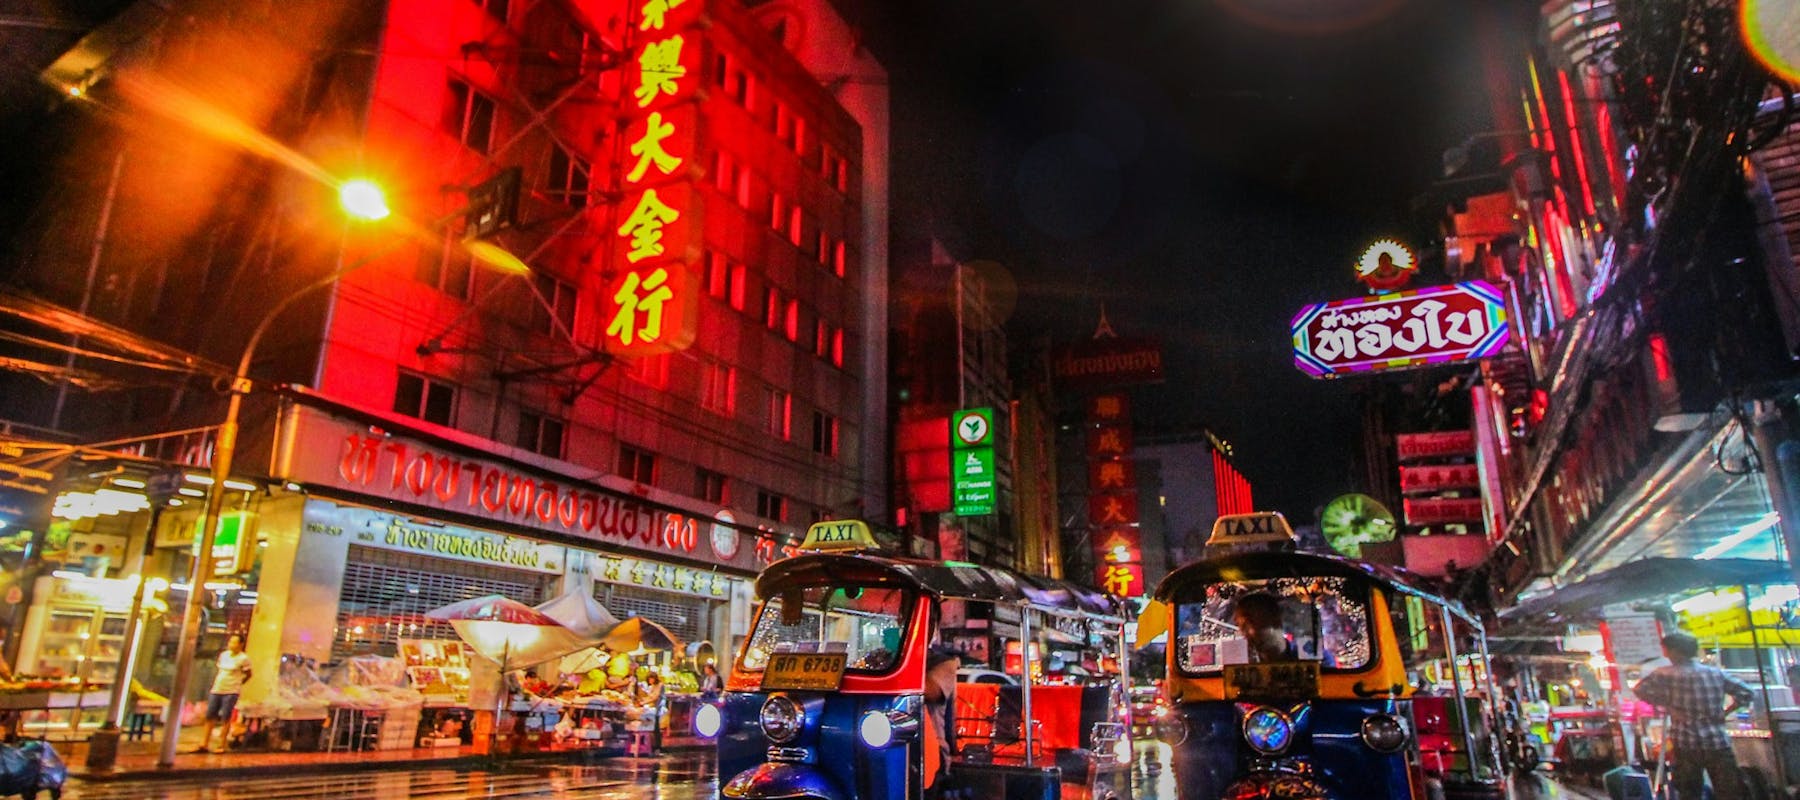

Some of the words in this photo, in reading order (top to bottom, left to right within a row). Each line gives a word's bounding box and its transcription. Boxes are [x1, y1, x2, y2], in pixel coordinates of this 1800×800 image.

[1314, 299, 1486, 361] ทองใบ
[339, 425, 698, 553] ห้างขายทองจนฮั้วเฮง
[814, 524, 854, 542] TAXI
[1222, 517, 1274, 536] TAXI
[803, 656, 841, 673] 6738
